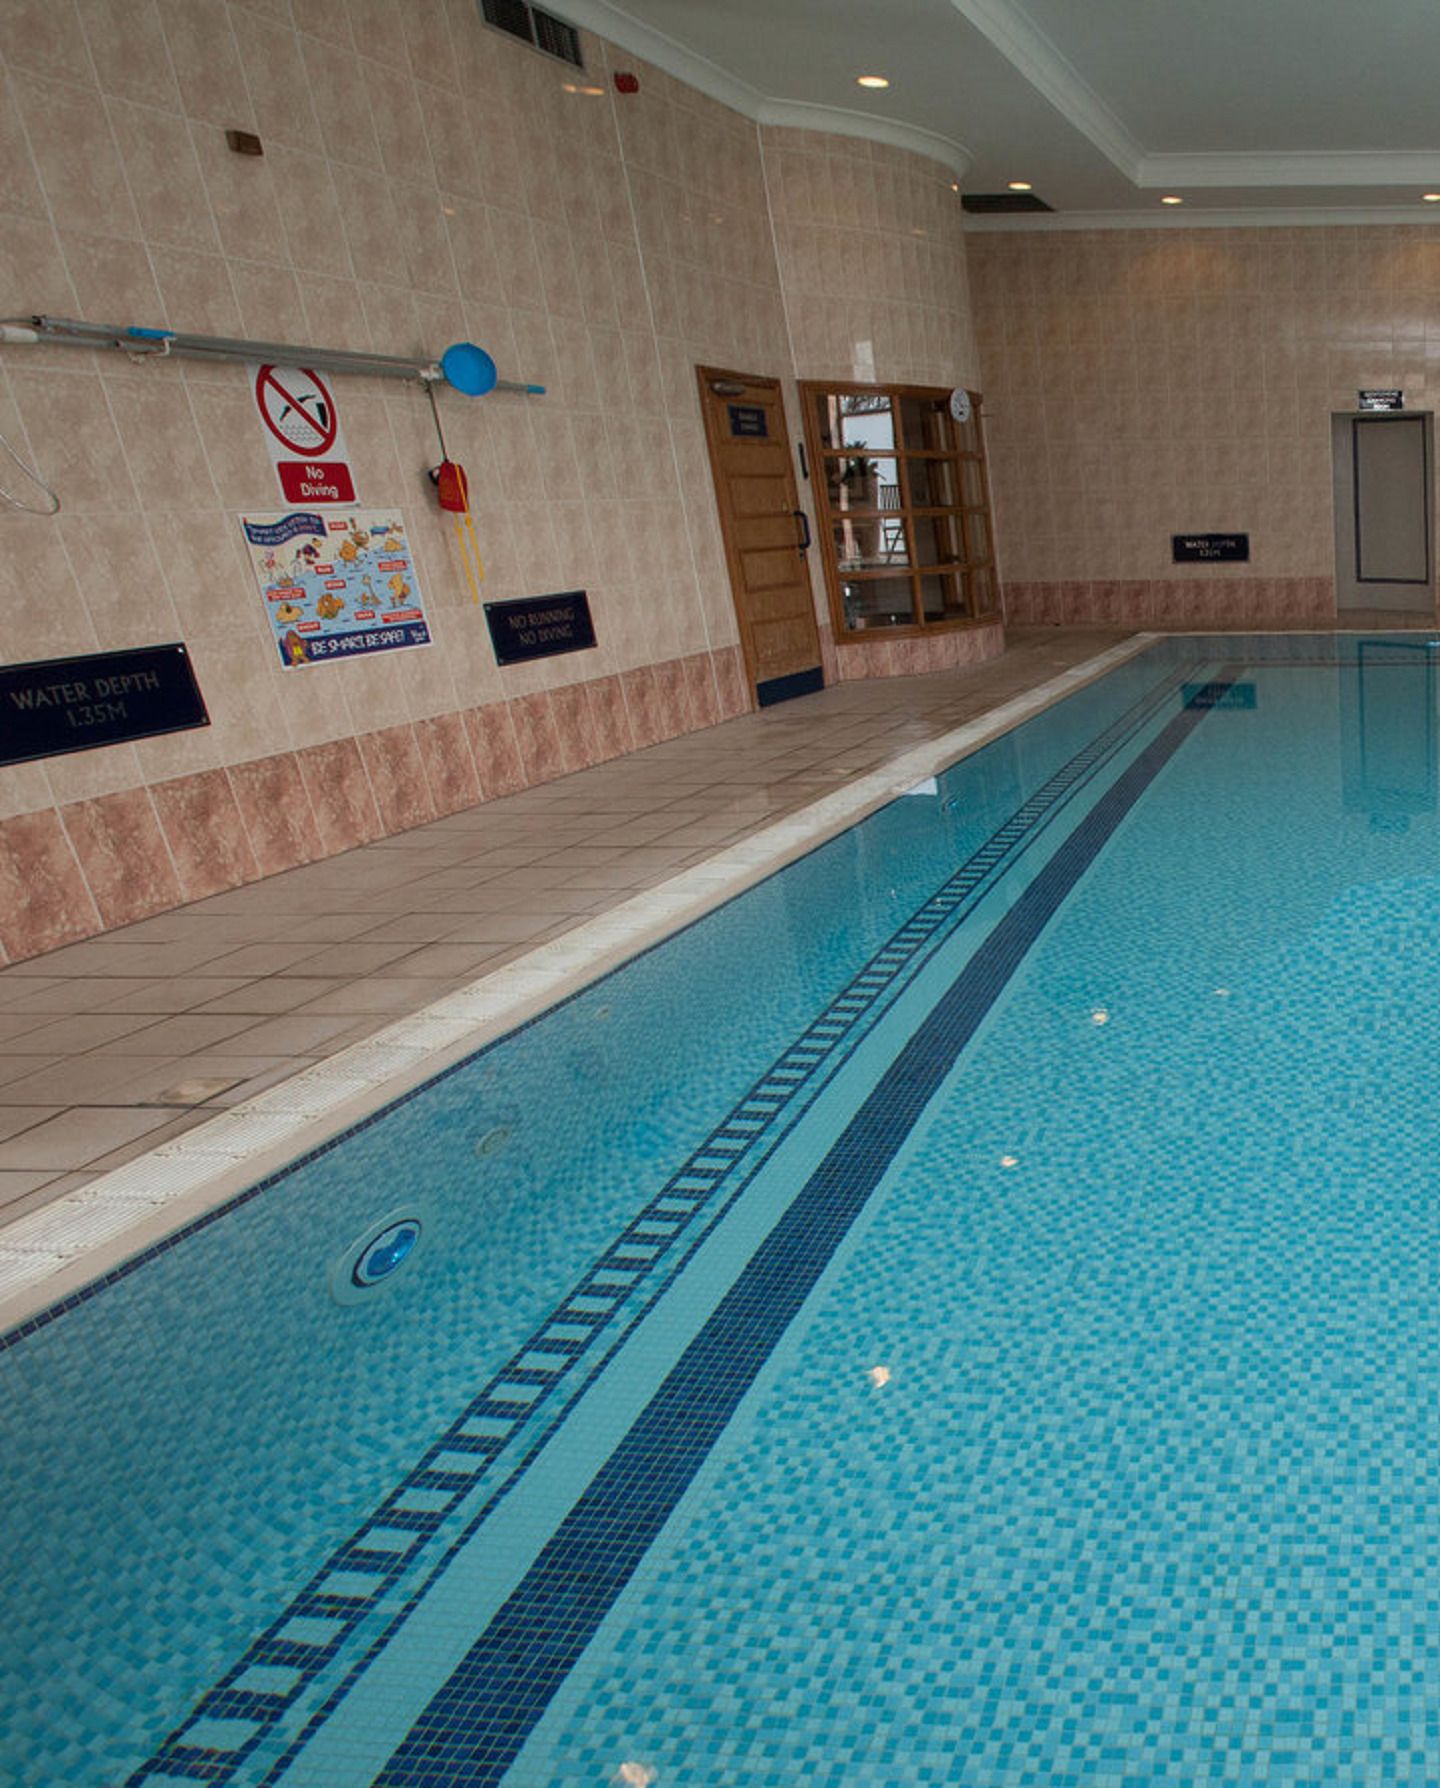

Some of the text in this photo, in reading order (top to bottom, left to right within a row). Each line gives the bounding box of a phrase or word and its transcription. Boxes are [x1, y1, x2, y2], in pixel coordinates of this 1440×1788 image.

[305, 465, 324, 479] No
[300, 482, 339, 500] Diving
[507, 606, 575, 630] NO RUNNING
[519, 623, 574, 646] NO DIVING
[11, 671, 160, 710] WATER DEPTH
[67, 701, 128, 727] 1.35M
